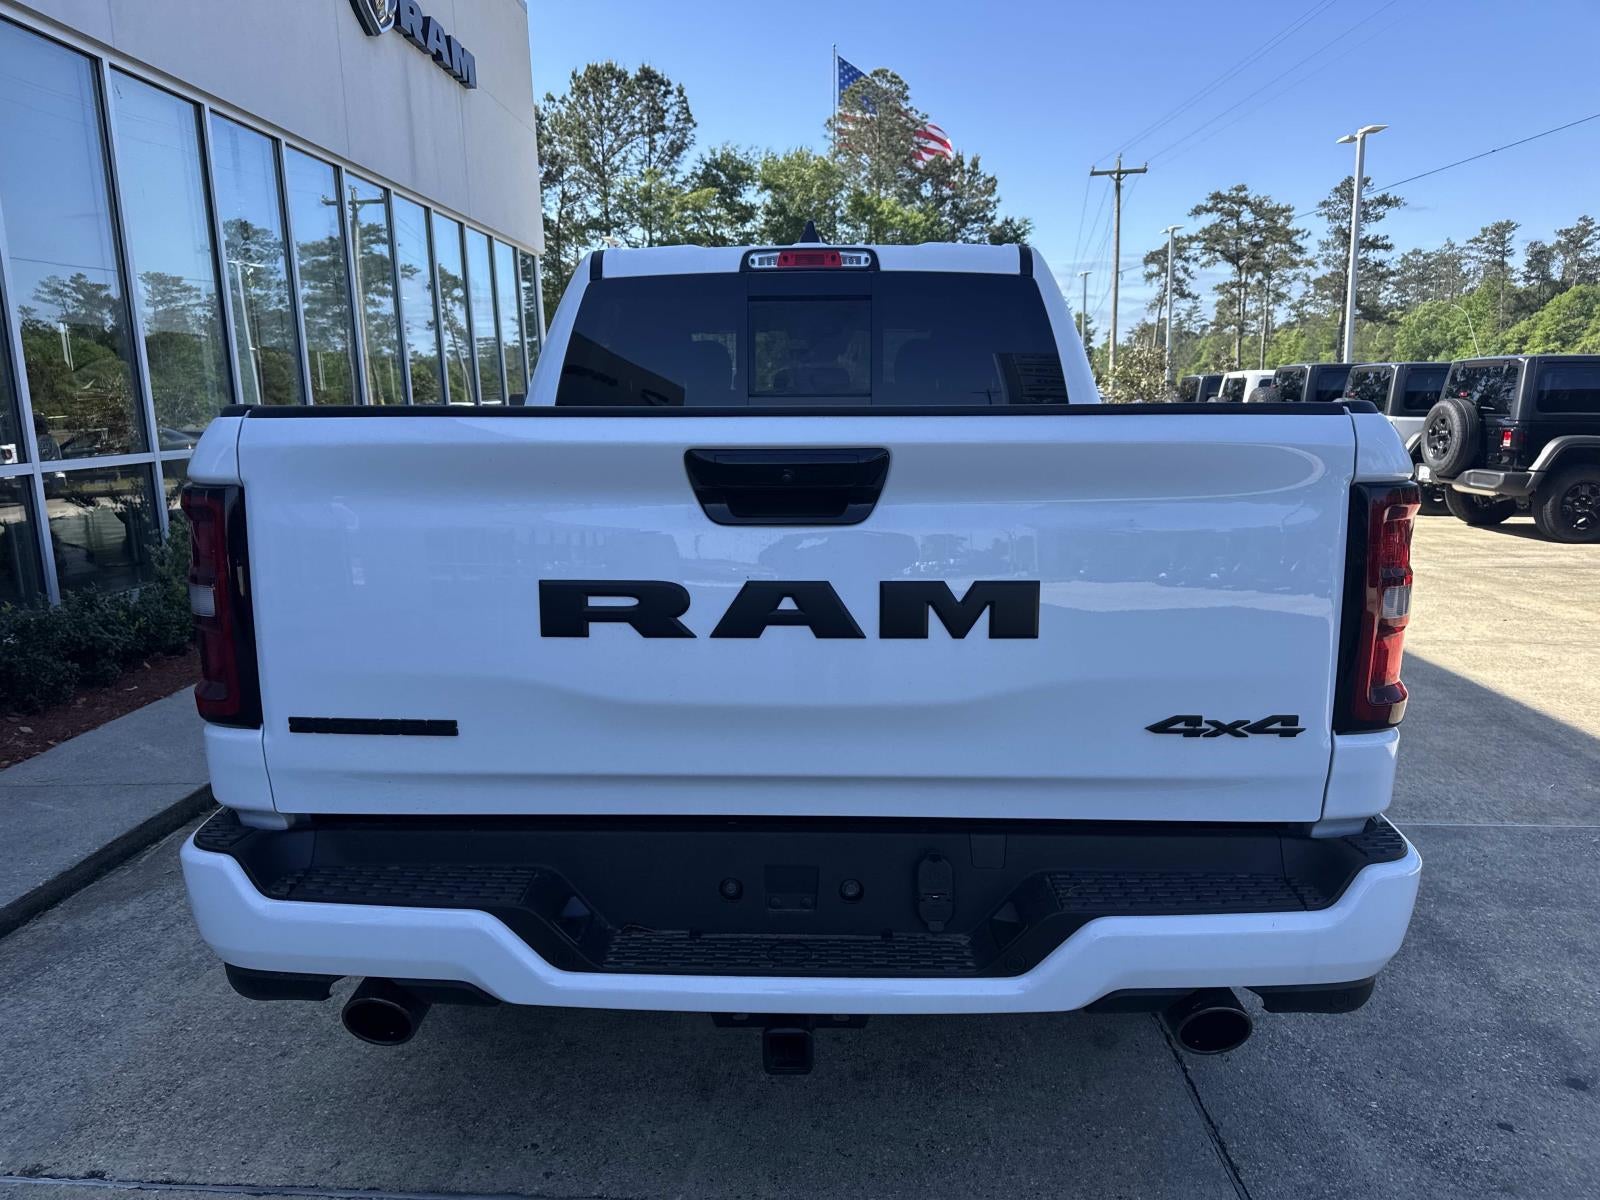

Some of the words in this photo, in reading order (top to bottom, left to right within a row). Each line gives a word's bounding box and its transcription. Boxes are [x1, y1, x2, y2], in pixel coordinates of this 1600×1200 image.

[393, 0, 477, 89] RAM
[539, 579, 1041, 639] RAM
[1144, 714, 1306, 738] 4x4
